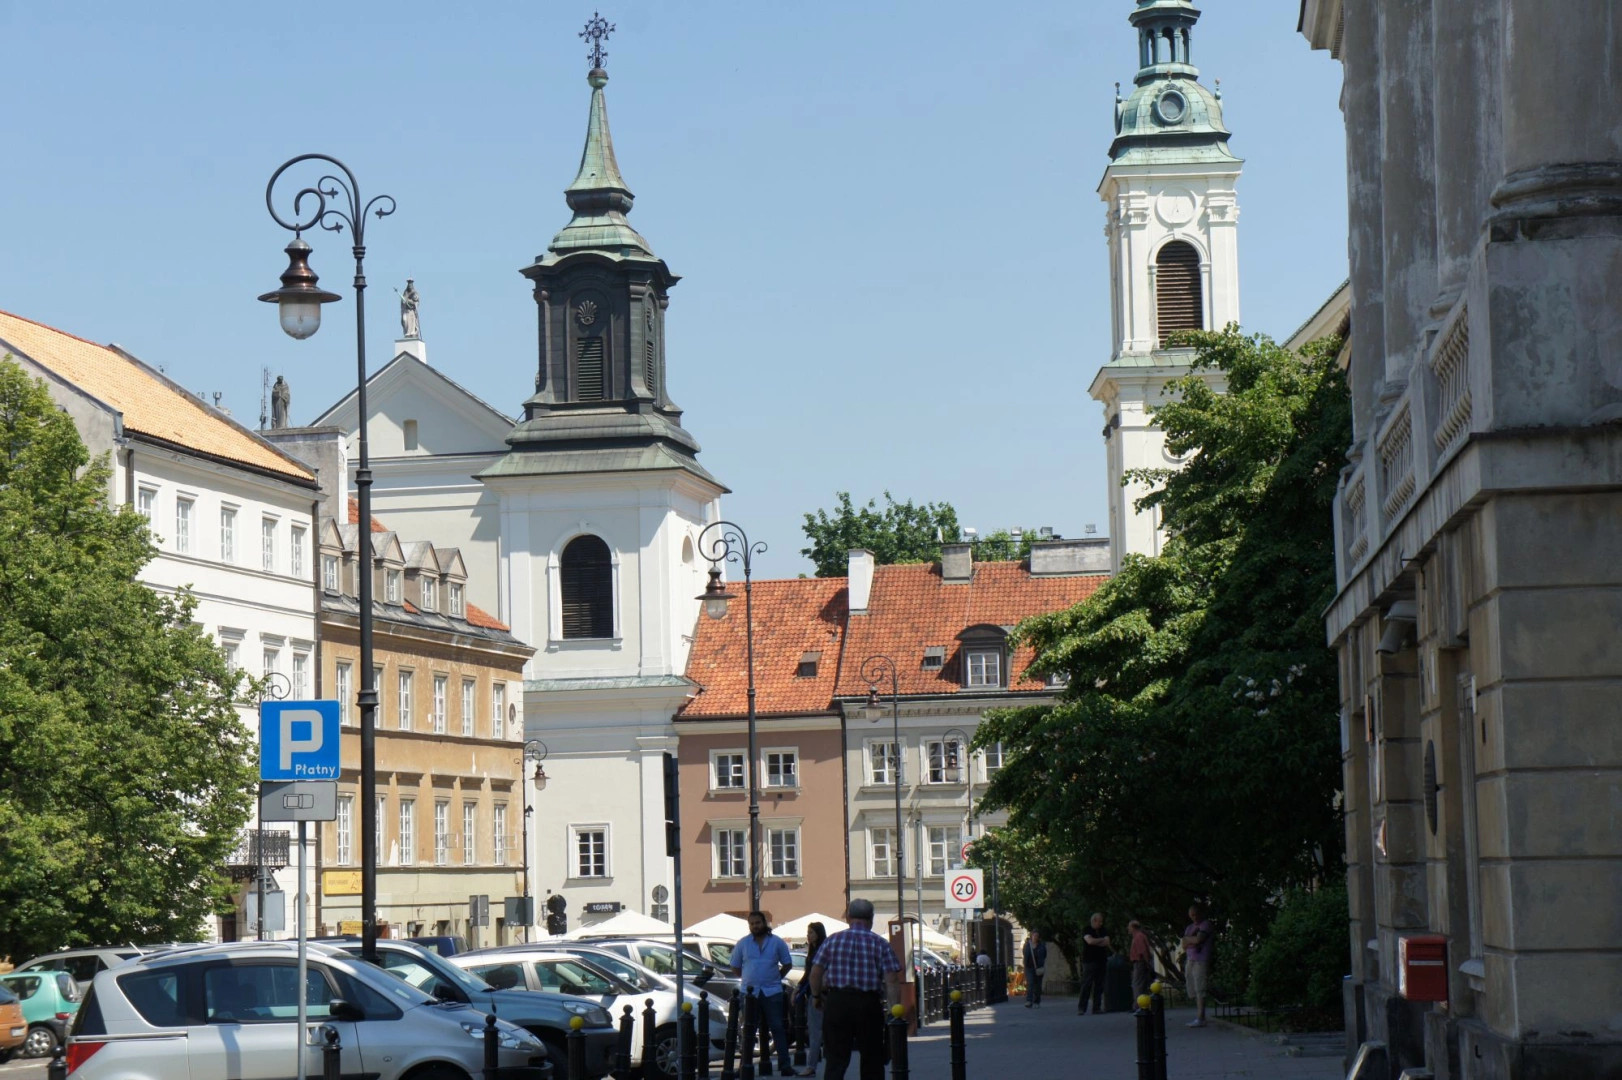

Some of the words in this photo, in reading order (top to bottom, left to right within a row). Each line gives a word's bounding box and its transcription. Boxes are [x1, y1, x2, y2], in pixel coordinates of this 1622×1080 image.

[280, 709, 323, 770] P
[295, 764, 336, 777] Płatny
[956, 882, 974, 896] 20
[891, 924, 902, 936] P
